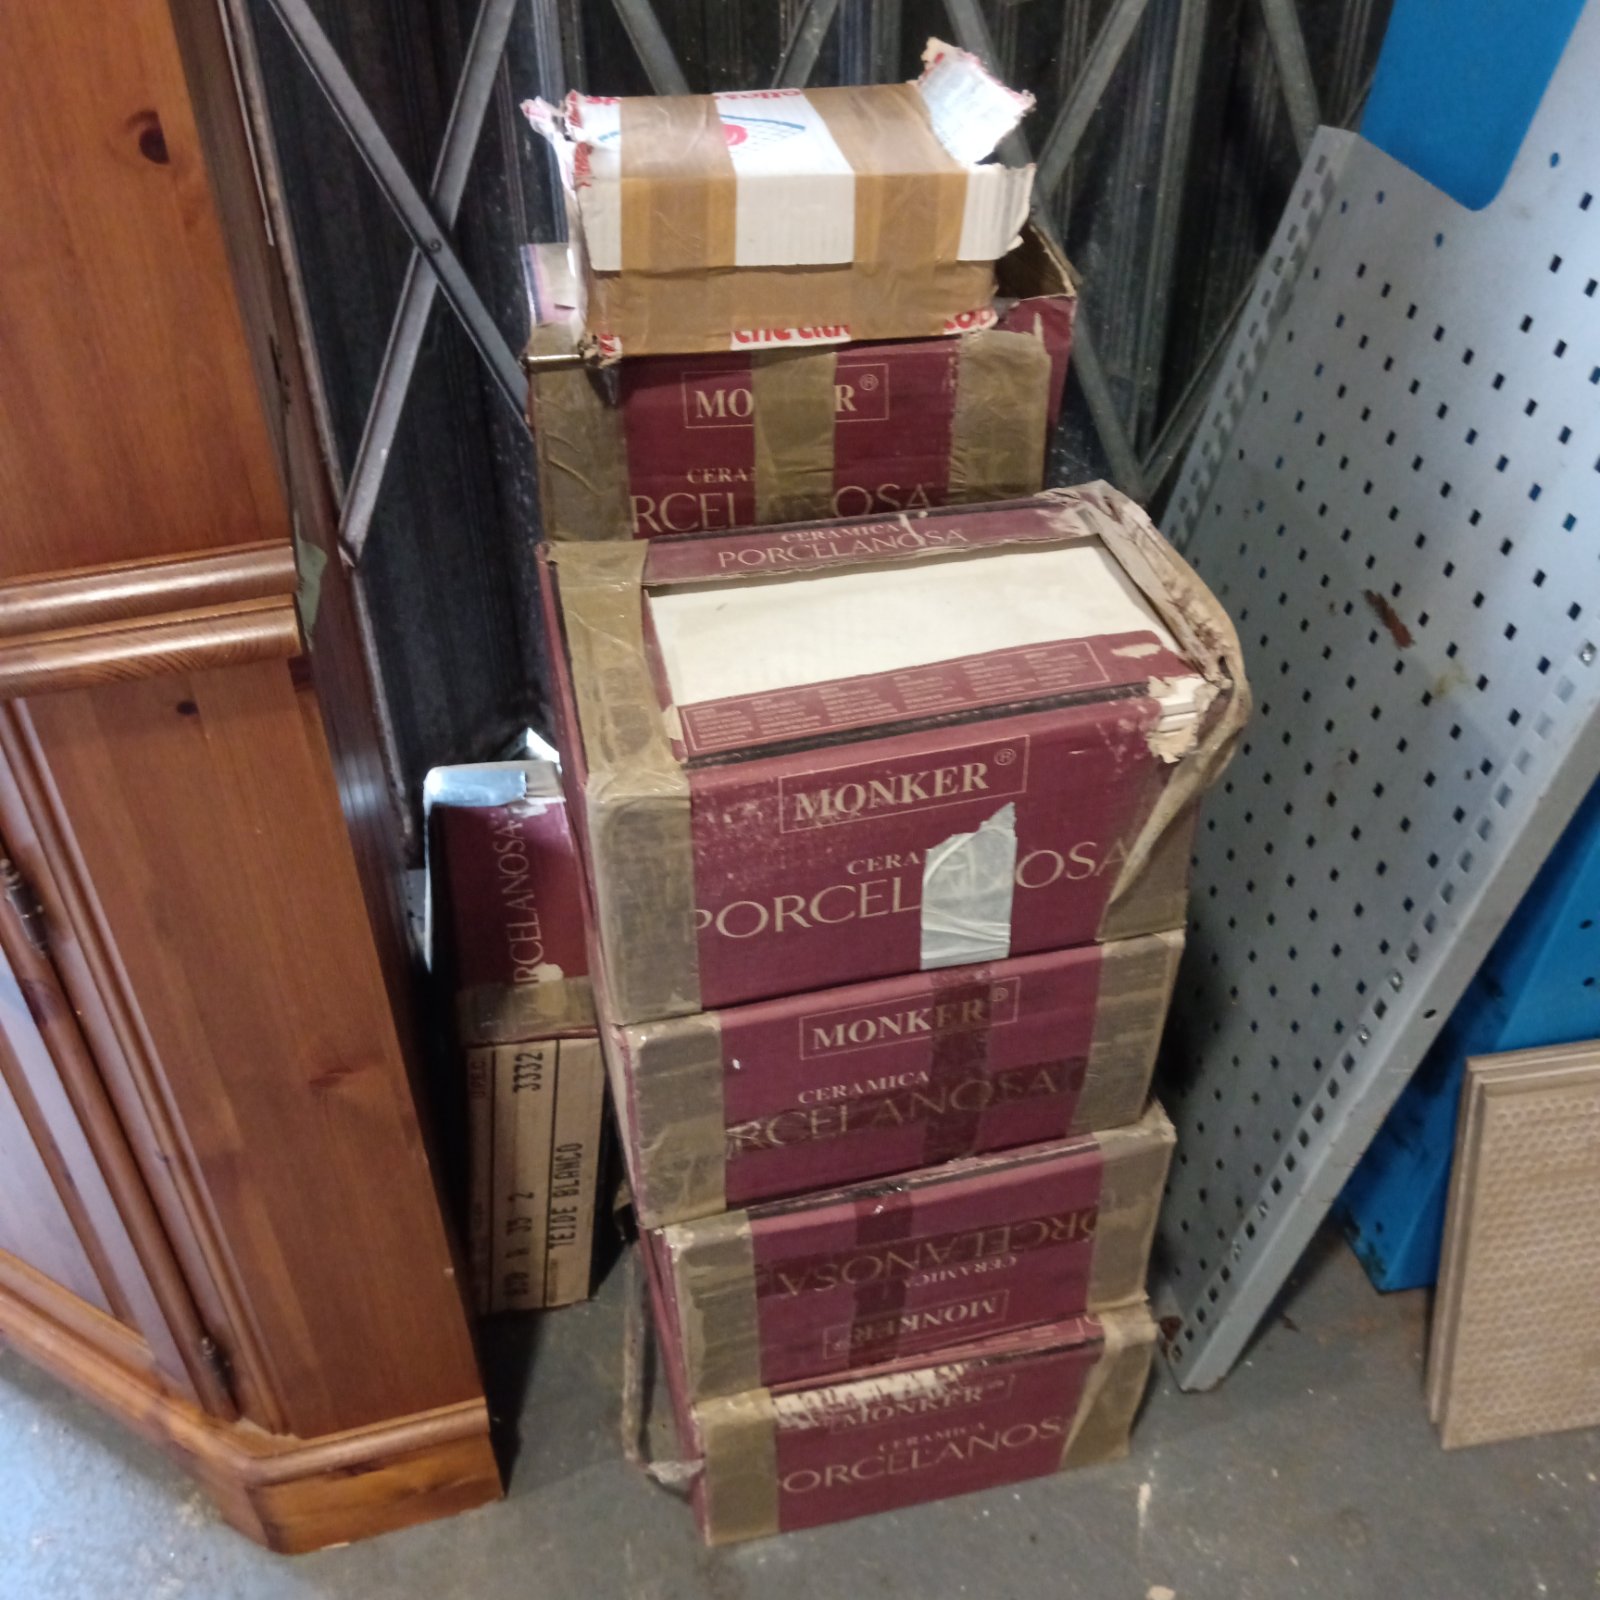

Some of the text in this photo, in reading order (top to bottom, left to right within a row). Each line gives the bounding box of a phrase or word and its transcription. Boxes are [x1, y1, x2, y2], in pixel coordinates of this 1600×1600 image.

[695, 385, 857, 418] MOR
[687, 466, 757, 485] CERA
[631, 483, 932, 533] RCELOSA
[718, 528, 970, 569] PORCELANOSA
[781, 524, 902, 544] CERAMICA
[793, 762, 989, 822] MONKER
[847, 849, 926, 876] CERA
[493, 819, 545, 985] RCELANOSA
[694, 840, 1130, 938] PORCELOSA
[812, 998, 988, 1050] MONKER
[512, 1052, 544, 1094] 3332
[798, 1070, 930, 1104] CERAMICA
[727, 1067, 1058, 1149] RCELANOSA
[547, 1143, 583, 1250] TEIDE BLANCO
[901, 1254, 1019, 1289] CERAMICA
[852, 1297, 998, 1342] MONKER
[781, 1416, 1063, 1494] ORCELANOS
[879, 1421, 987, 1451] CERAMICA
